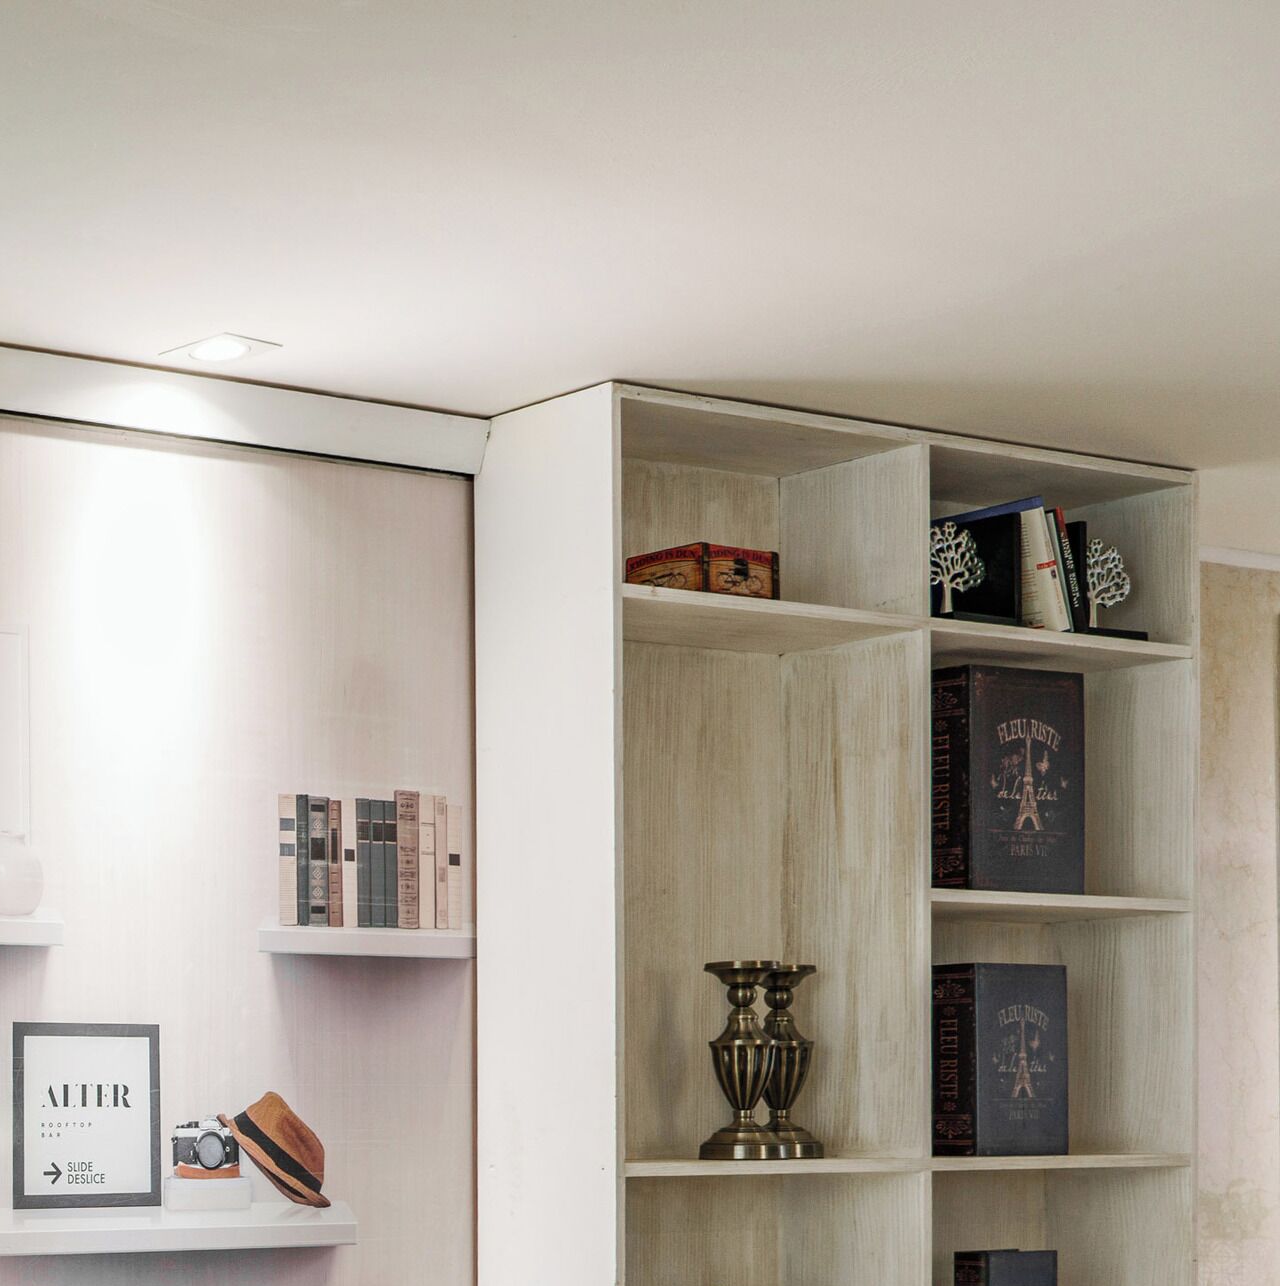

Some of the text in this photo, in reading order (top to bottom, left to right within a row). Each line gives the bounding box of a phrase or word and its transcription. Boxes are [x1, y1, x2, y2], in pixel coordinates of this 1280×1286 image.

[41, 1084, 132, 1108] ALTER
[67, 1161, 93, 1172] SLIDE
[67, 1173, 105, 1184] DESLICE
